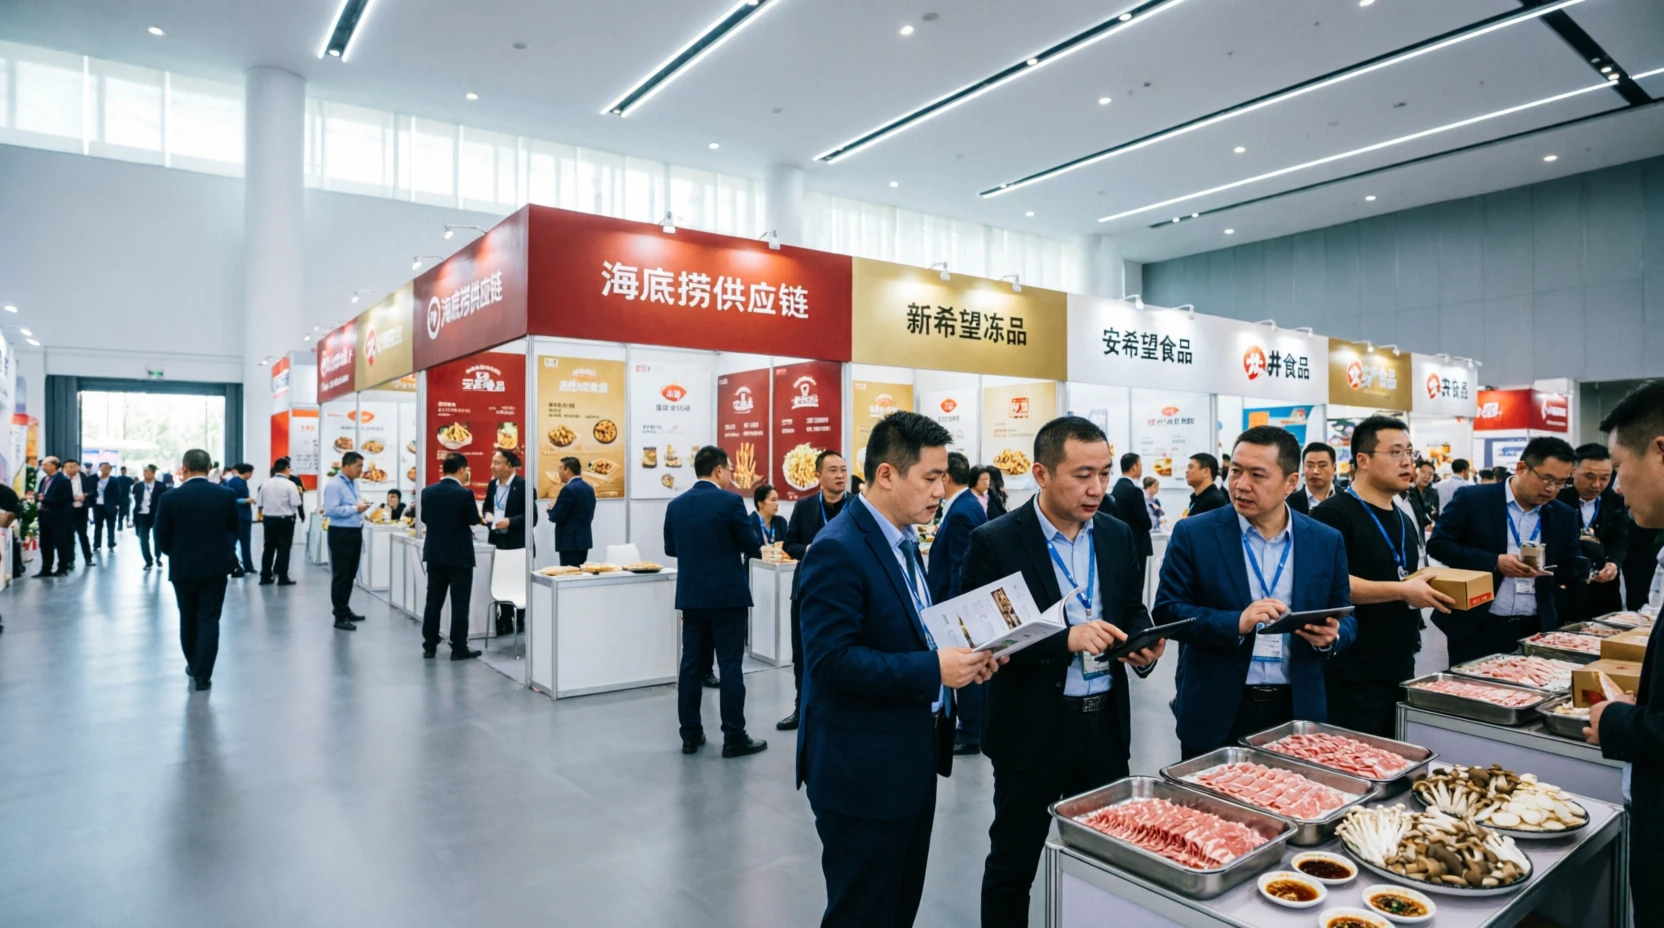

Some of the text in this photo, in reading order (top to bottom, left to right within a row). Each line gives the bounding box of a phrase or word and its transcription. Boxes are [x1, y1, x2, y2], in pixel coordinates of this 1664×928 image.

[601, 260, 809, 319] 海底捞供应链
[906, 302, 1027, 346] 新希望冻品
[1102, 327, 1193, 365] 安希望食品
